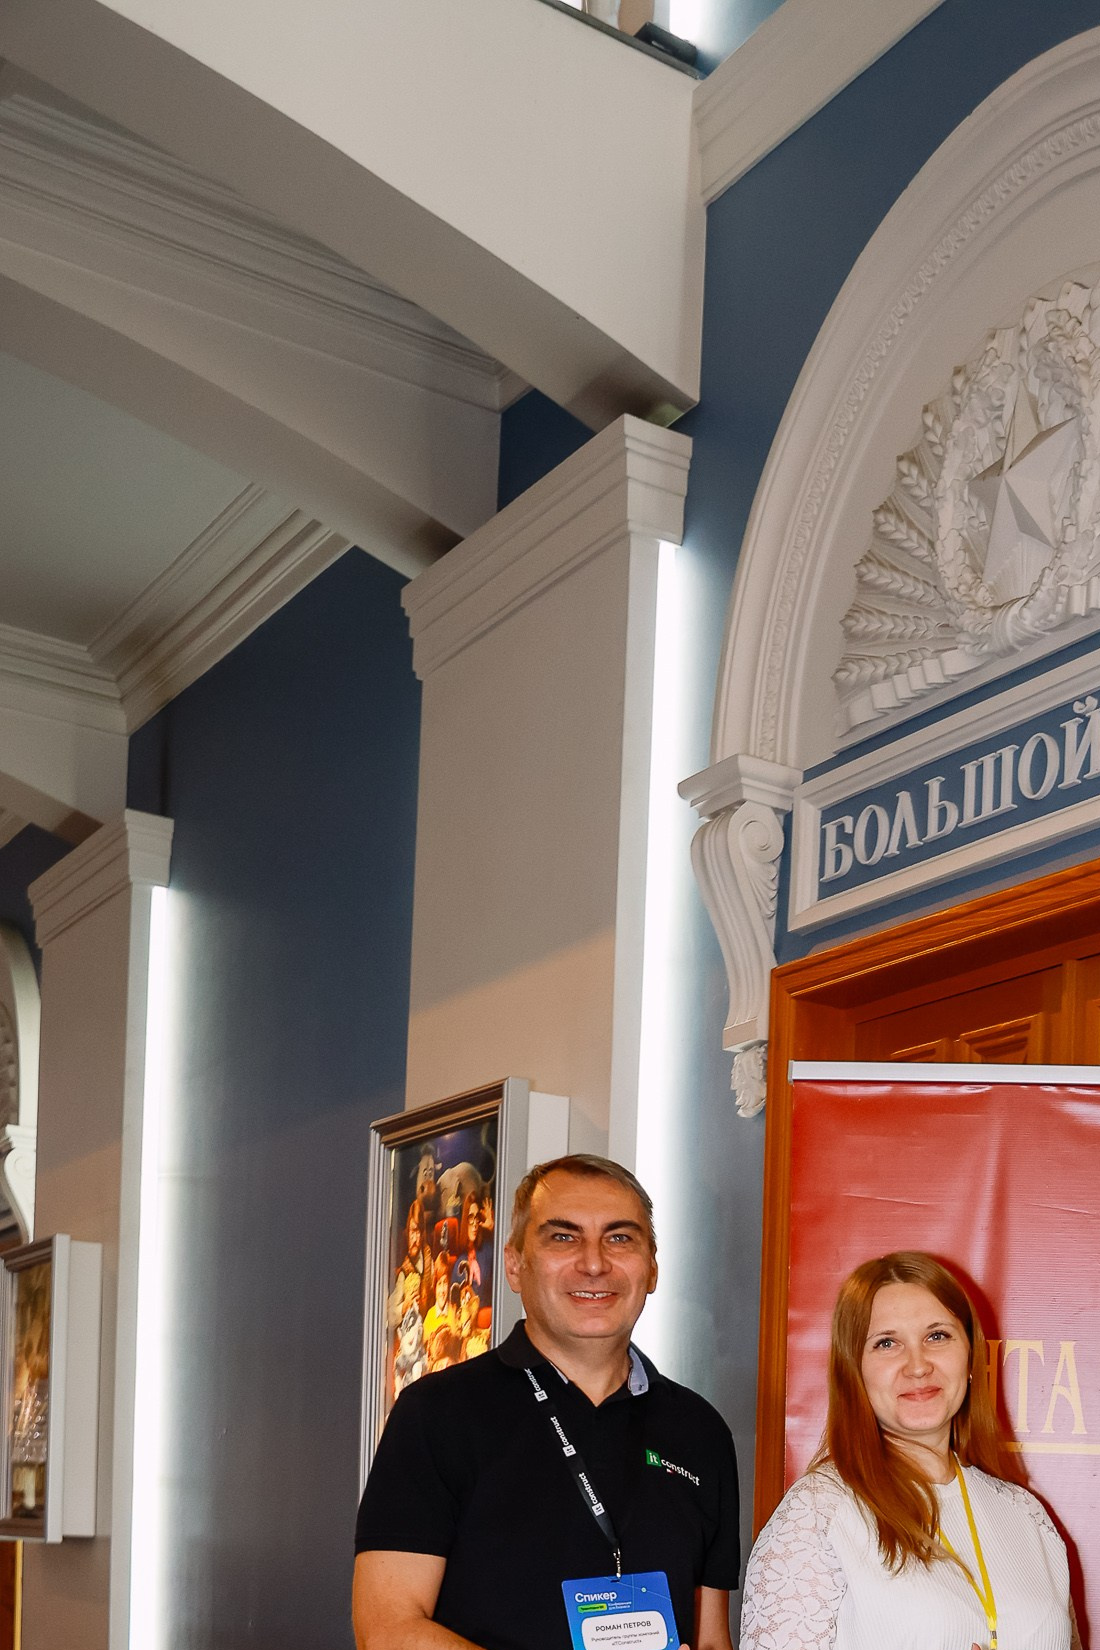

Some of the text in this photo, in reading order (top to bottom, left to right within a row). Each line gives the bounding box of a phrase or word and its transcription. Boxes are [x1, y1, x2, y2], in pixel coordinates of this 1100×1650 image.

[574, 1591, 617, 1603] Спикер
[595, 1620, 652, 1632] РОМАН ПЕТРОВ
